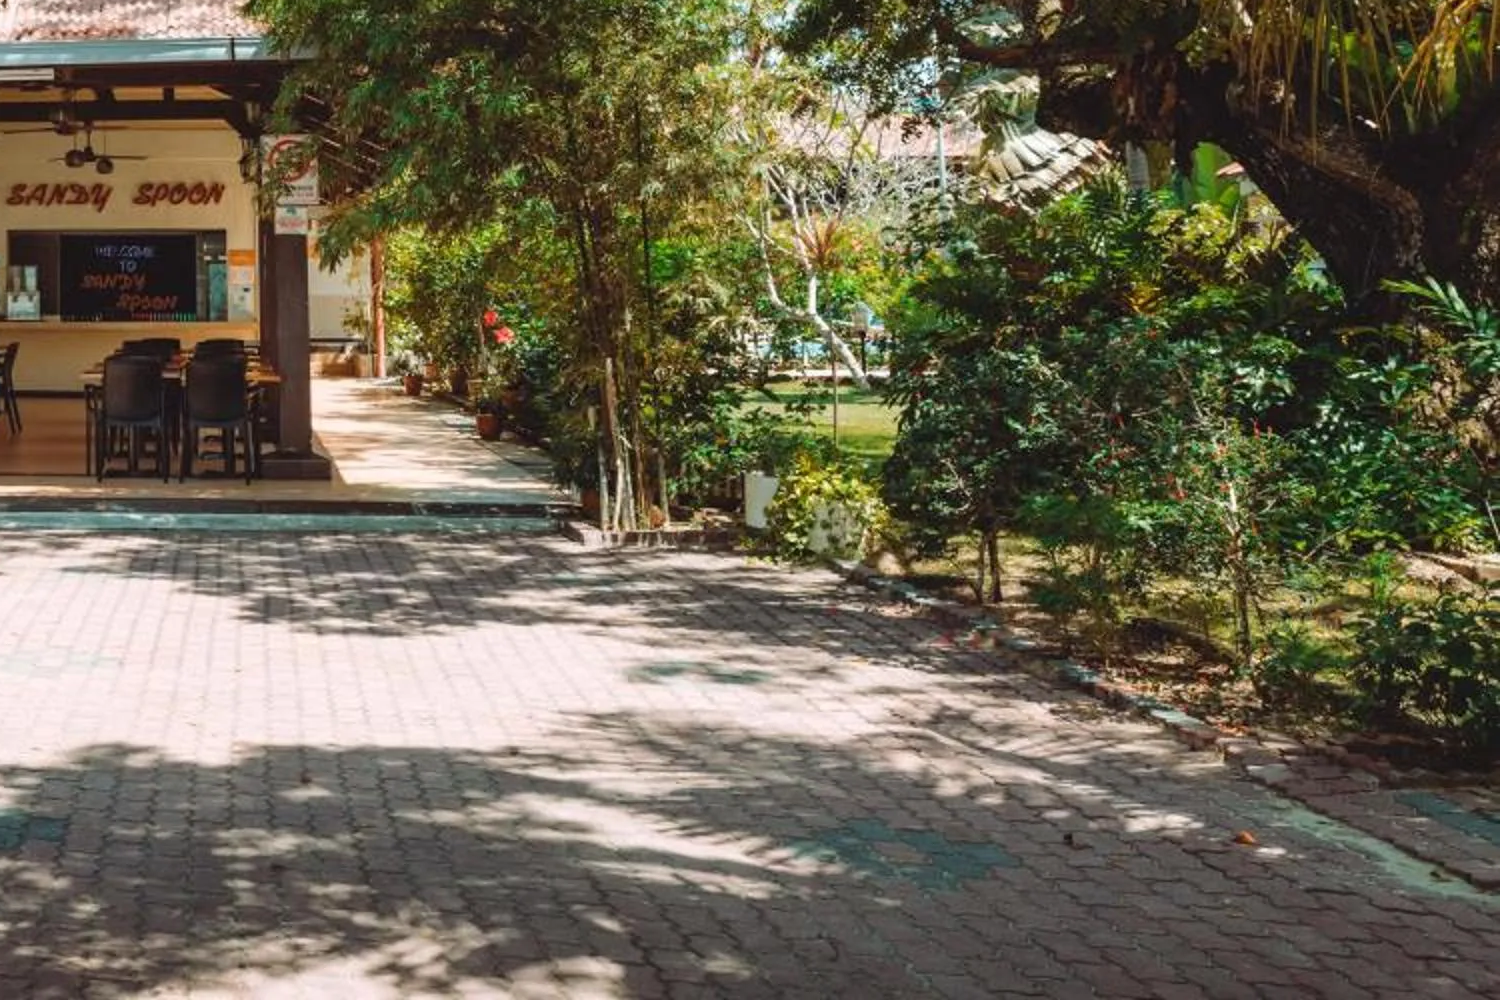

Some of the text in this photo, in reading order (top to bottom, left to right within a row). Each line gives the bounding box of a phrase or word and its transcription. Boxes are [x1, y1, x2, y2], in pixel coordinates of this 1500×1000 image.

[6, 182, 225, 213] SANDY SPOON
[119, 260, 138, 273] TO
[80, 273, 146, 290] SANDY
[115, 293, 178, 311] SPOON
